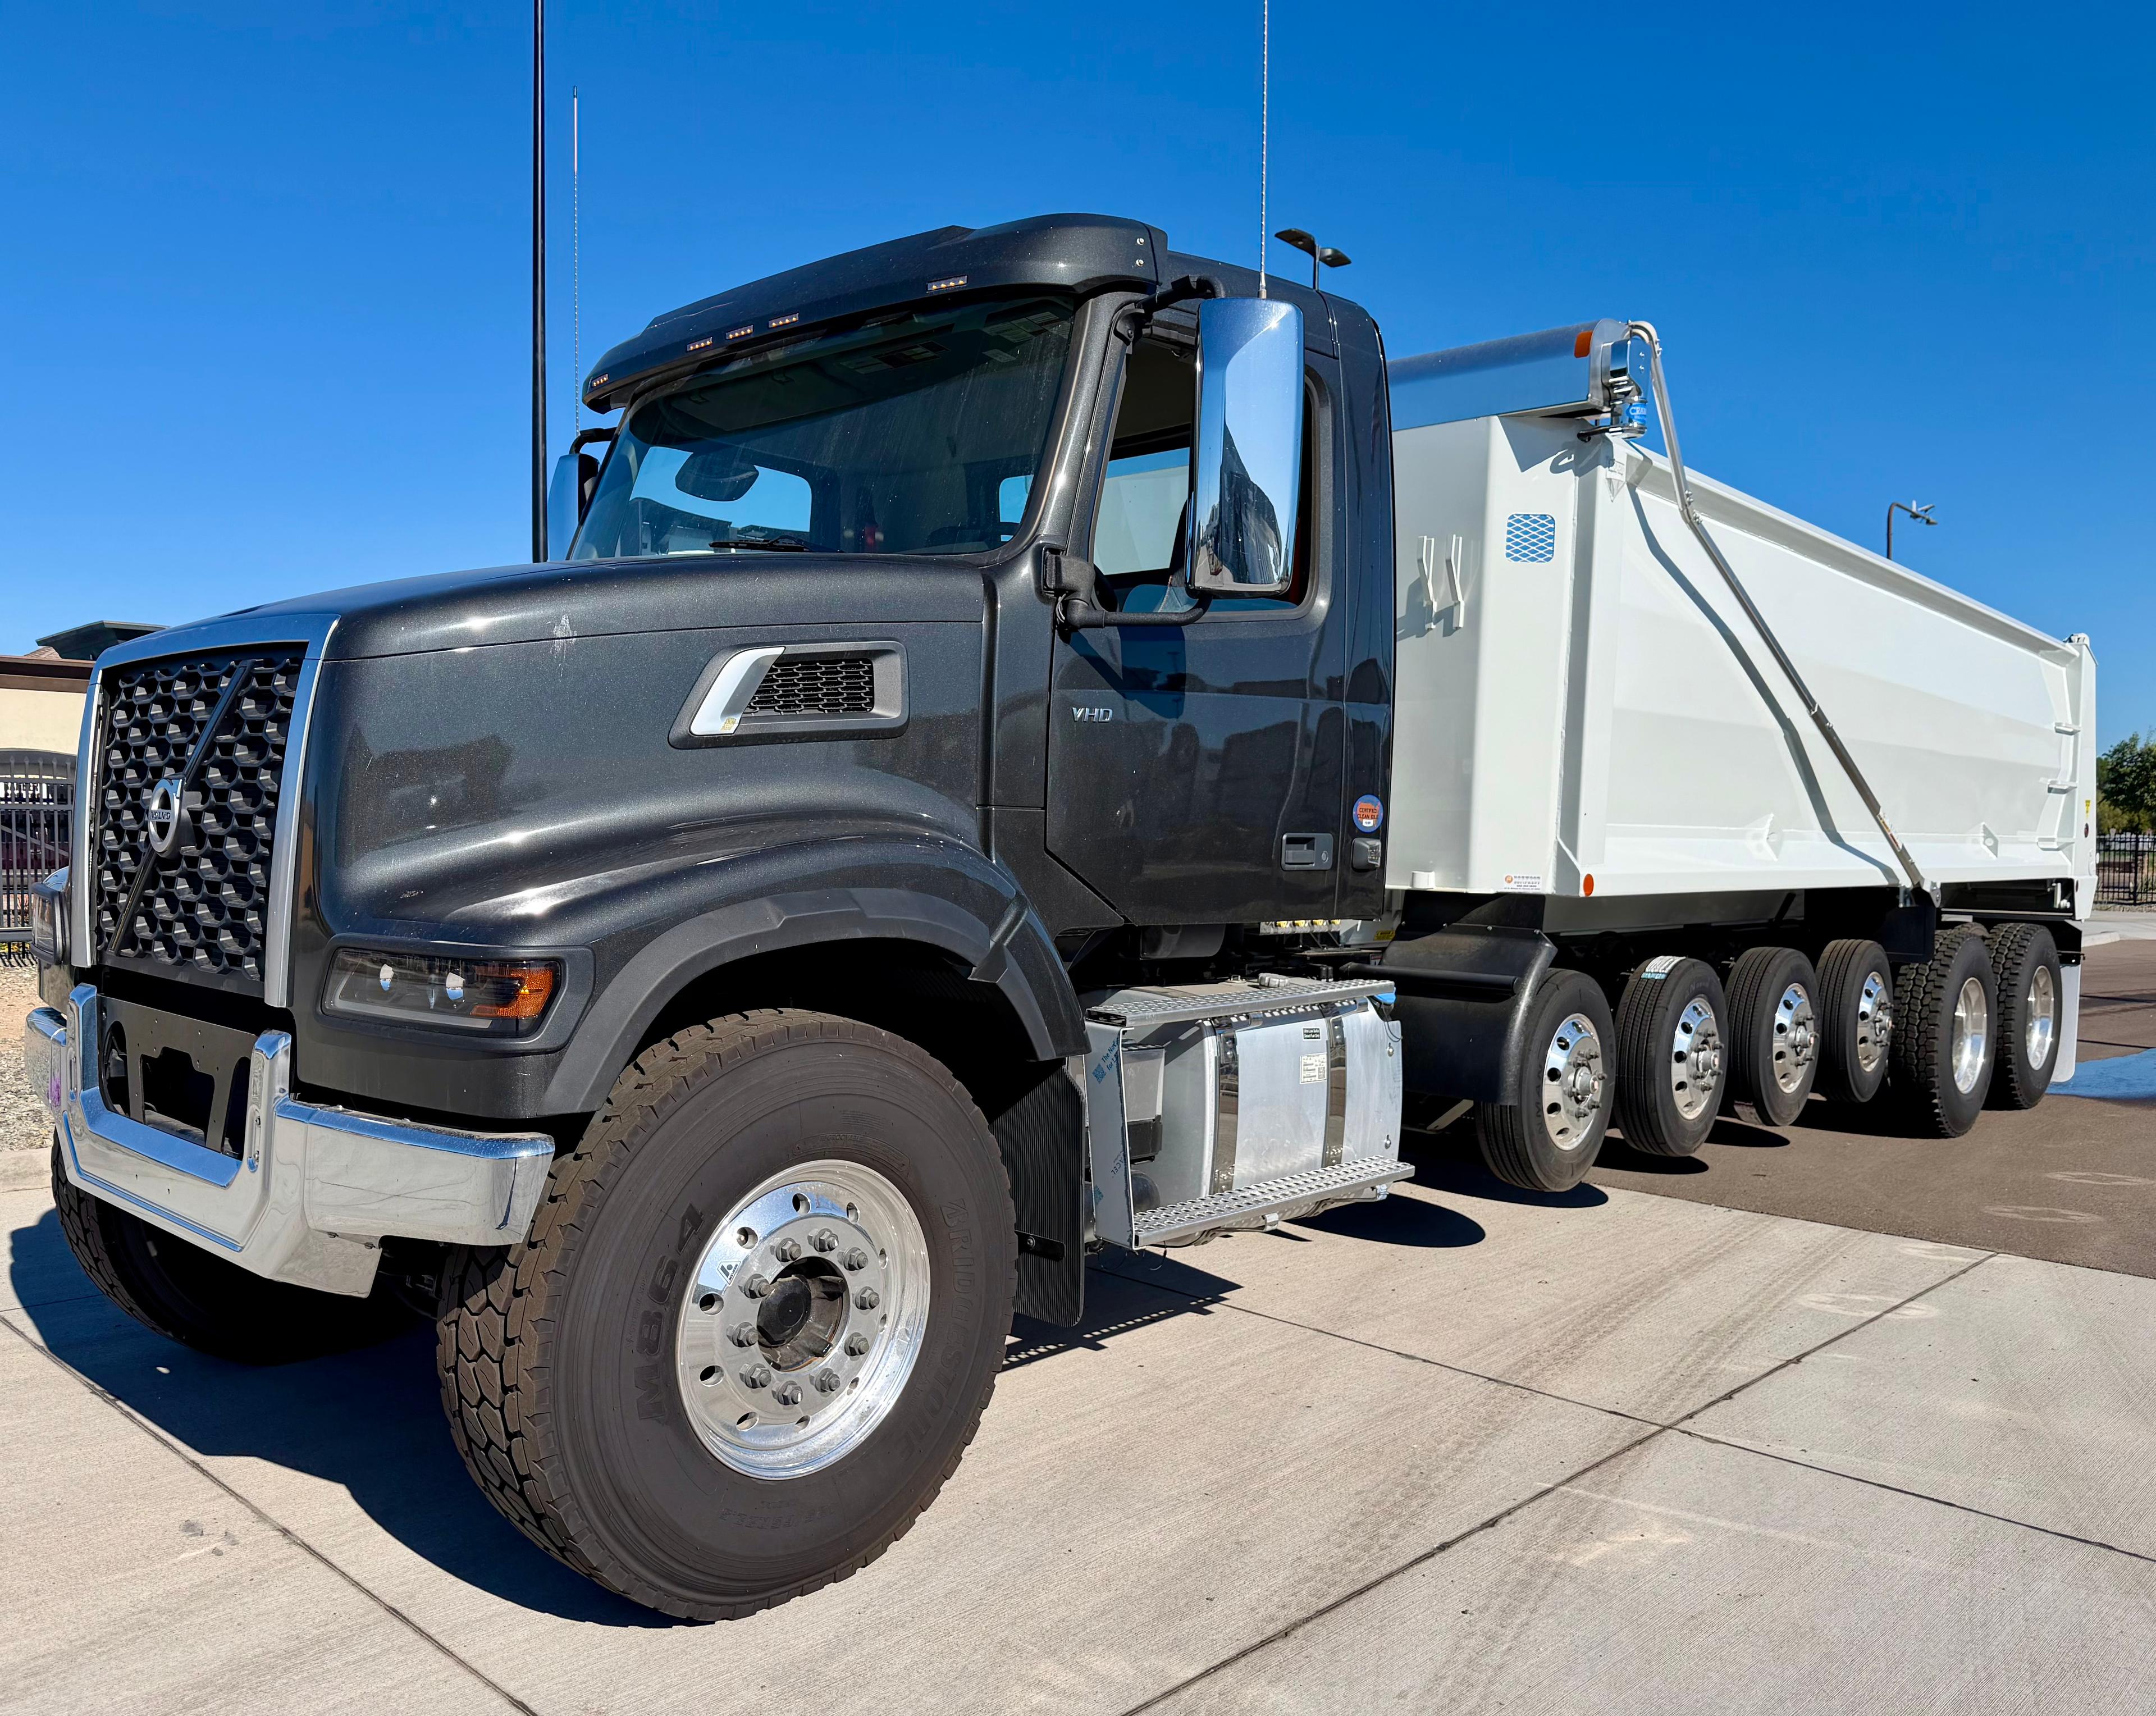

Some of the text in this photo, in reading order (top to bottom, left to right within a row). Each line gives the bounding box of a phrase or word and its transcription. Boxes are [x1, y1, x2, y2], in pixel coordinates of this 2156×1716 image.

[1072, 707, 1113, 723] VHD
[151, 811, 171, 820] VOLVO
[634, 1203, 704, 1420] M864
[899, 1198, 976, 1460] BRIDGESTONE
